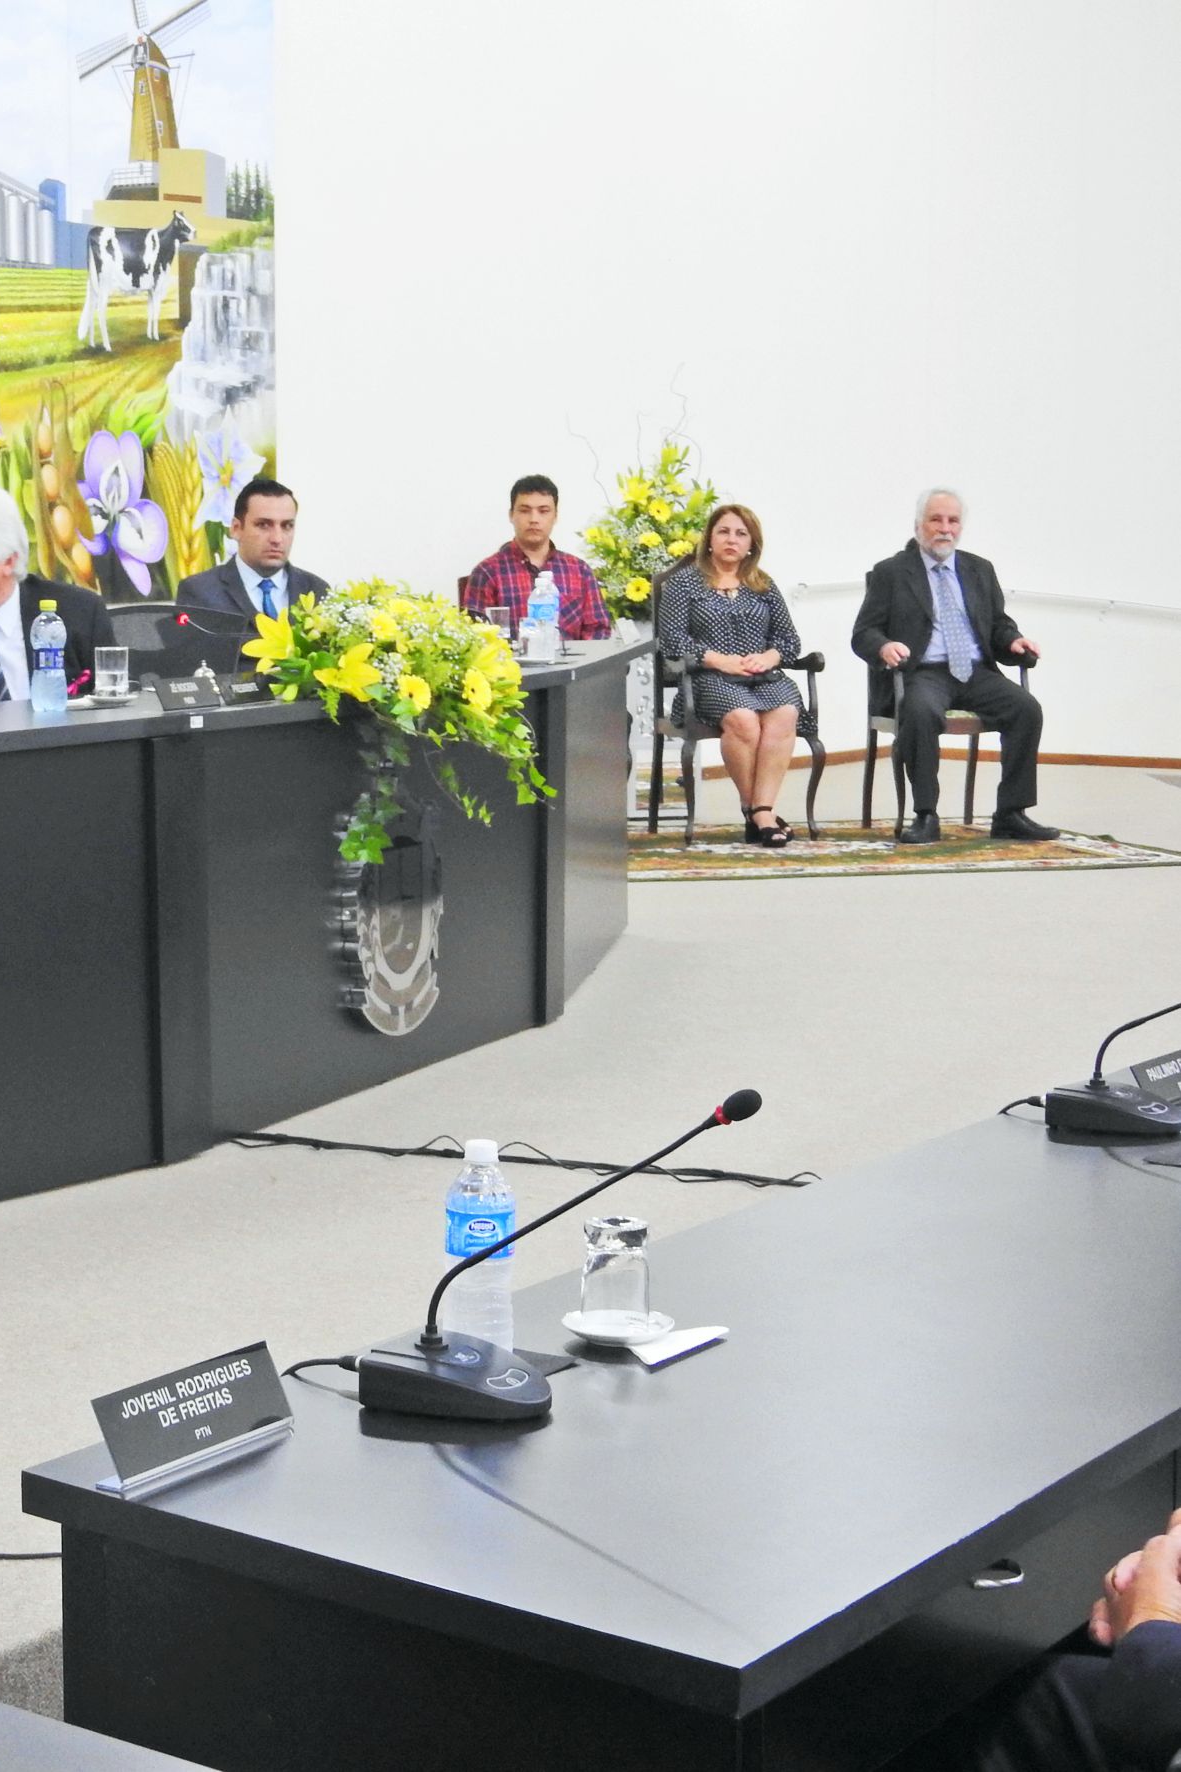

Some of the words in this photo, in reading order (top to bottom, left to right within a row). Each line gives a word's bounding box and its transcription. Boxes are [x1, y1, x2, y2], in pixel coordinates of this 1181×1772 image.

[121, 1387, 176, 1419] JOVENIL
[175, 1359, 252, 1399] RODRIGUES
[158, 1409, 179, 1427] DE
[181, 1387, 233, 1420] FREITAS
[194, 1424, 212, 1440] PTN
